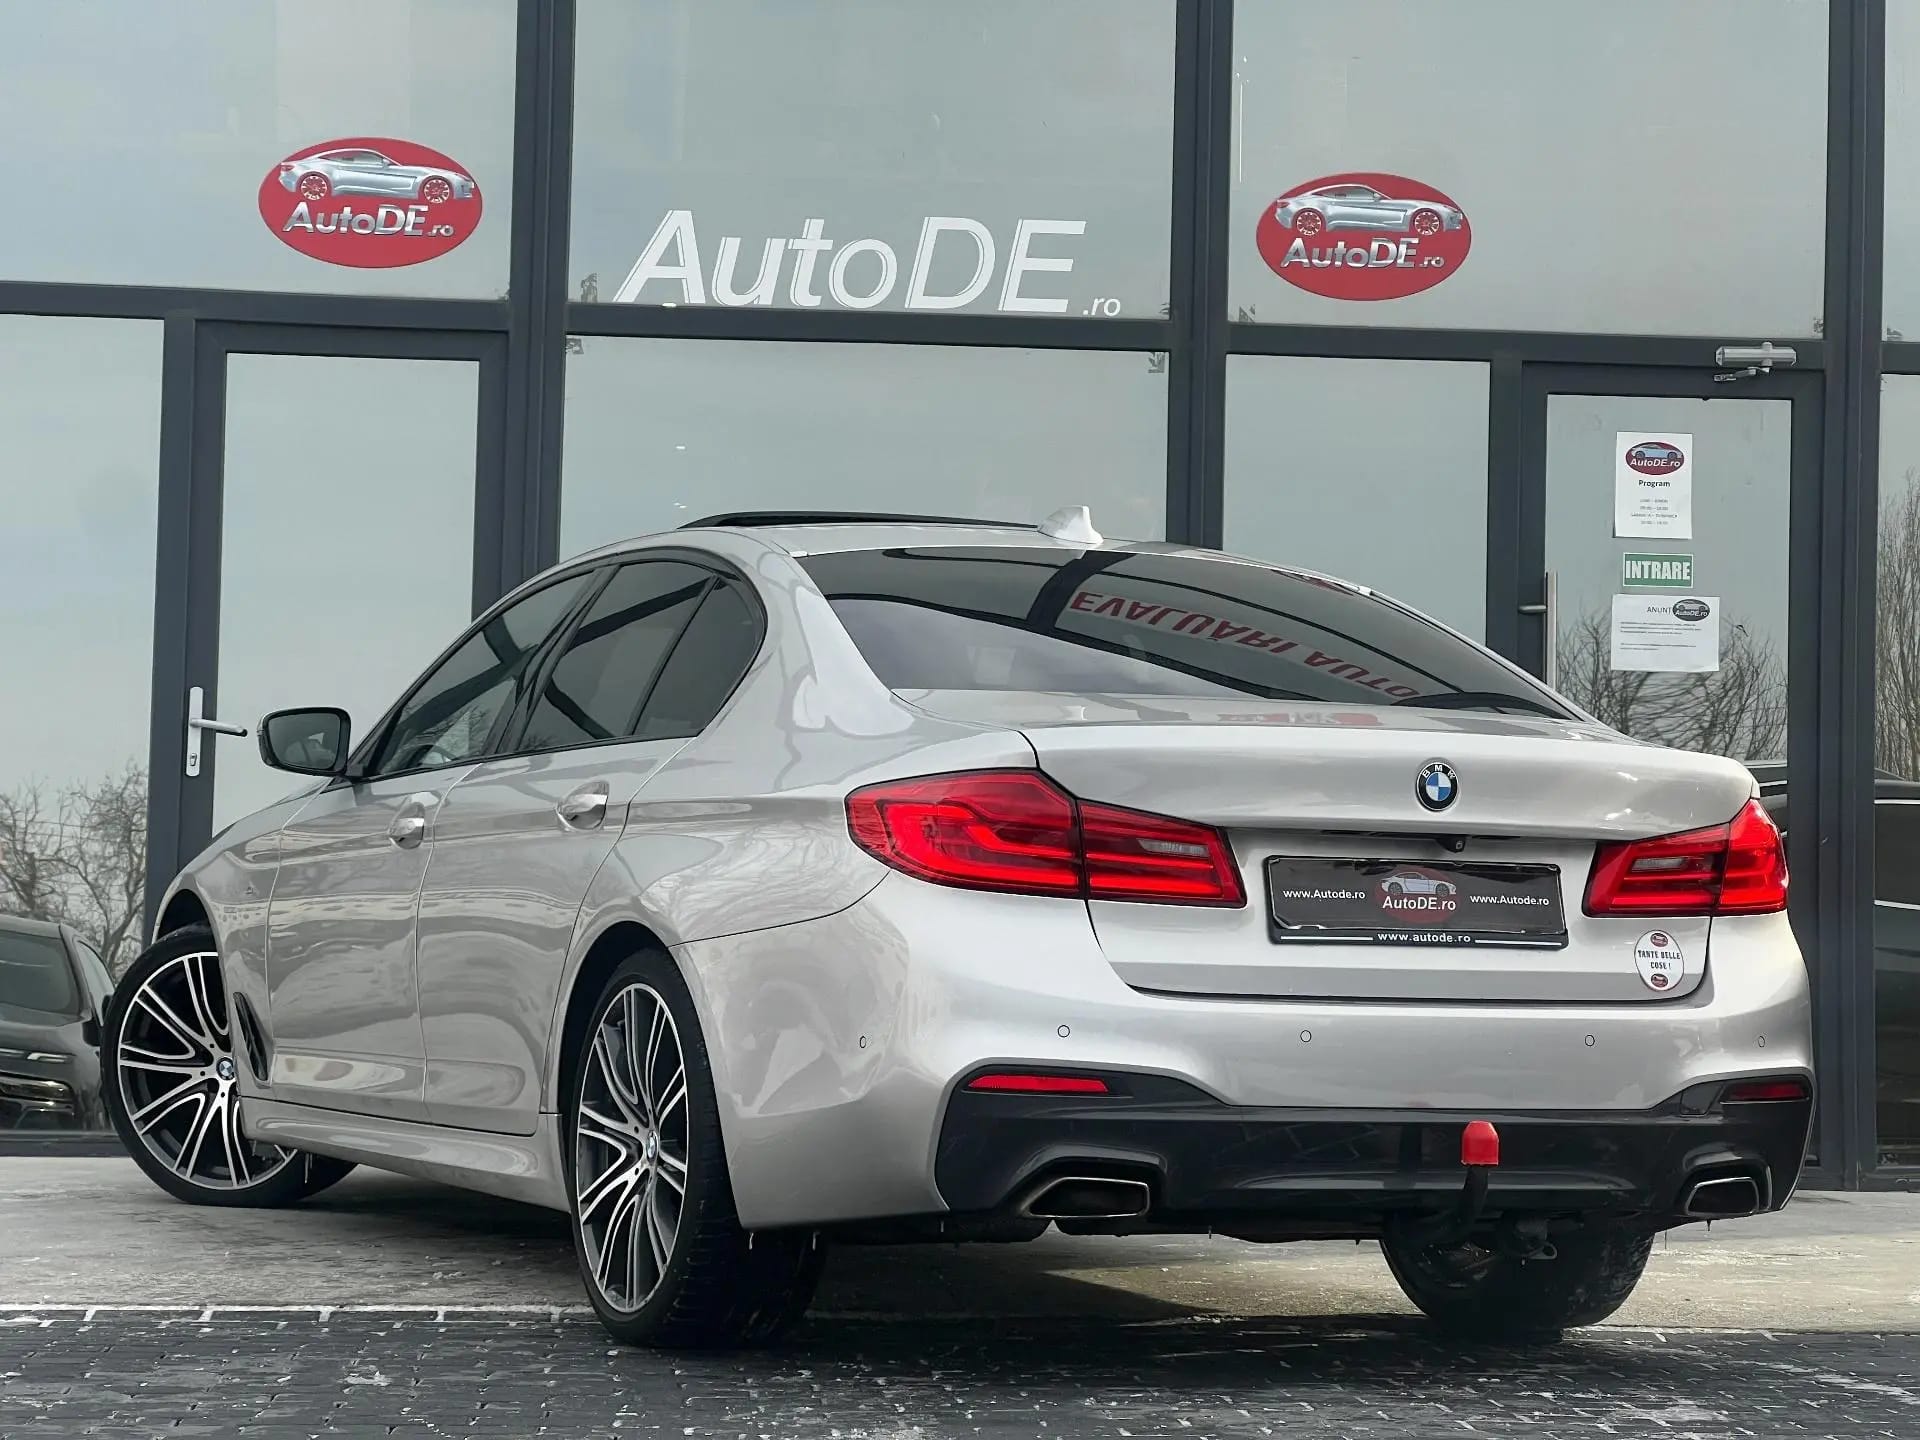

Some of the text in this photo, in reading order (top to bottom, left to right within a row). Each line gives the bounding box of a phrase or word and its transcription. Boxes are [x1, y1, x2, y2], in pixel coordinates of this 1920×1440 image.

[1630, 458, 1681, 468] AutoDE.ro
[1638, 480, 1671, 488] Program
[1625, 561, 1691, 581] INTRARE
[1422, 764, 1456, 779] BMW
[1283, 888, 1366, 900] www.Autode.ro
[1470, 893, 1550, 906] www.Autode.ro
[1382, 896, 1457, 911] AutoDE.ro
[1377, 931, 1471, 944] www.autode.ro
[1638, 950, 1681, 960] TANTE BELLE
